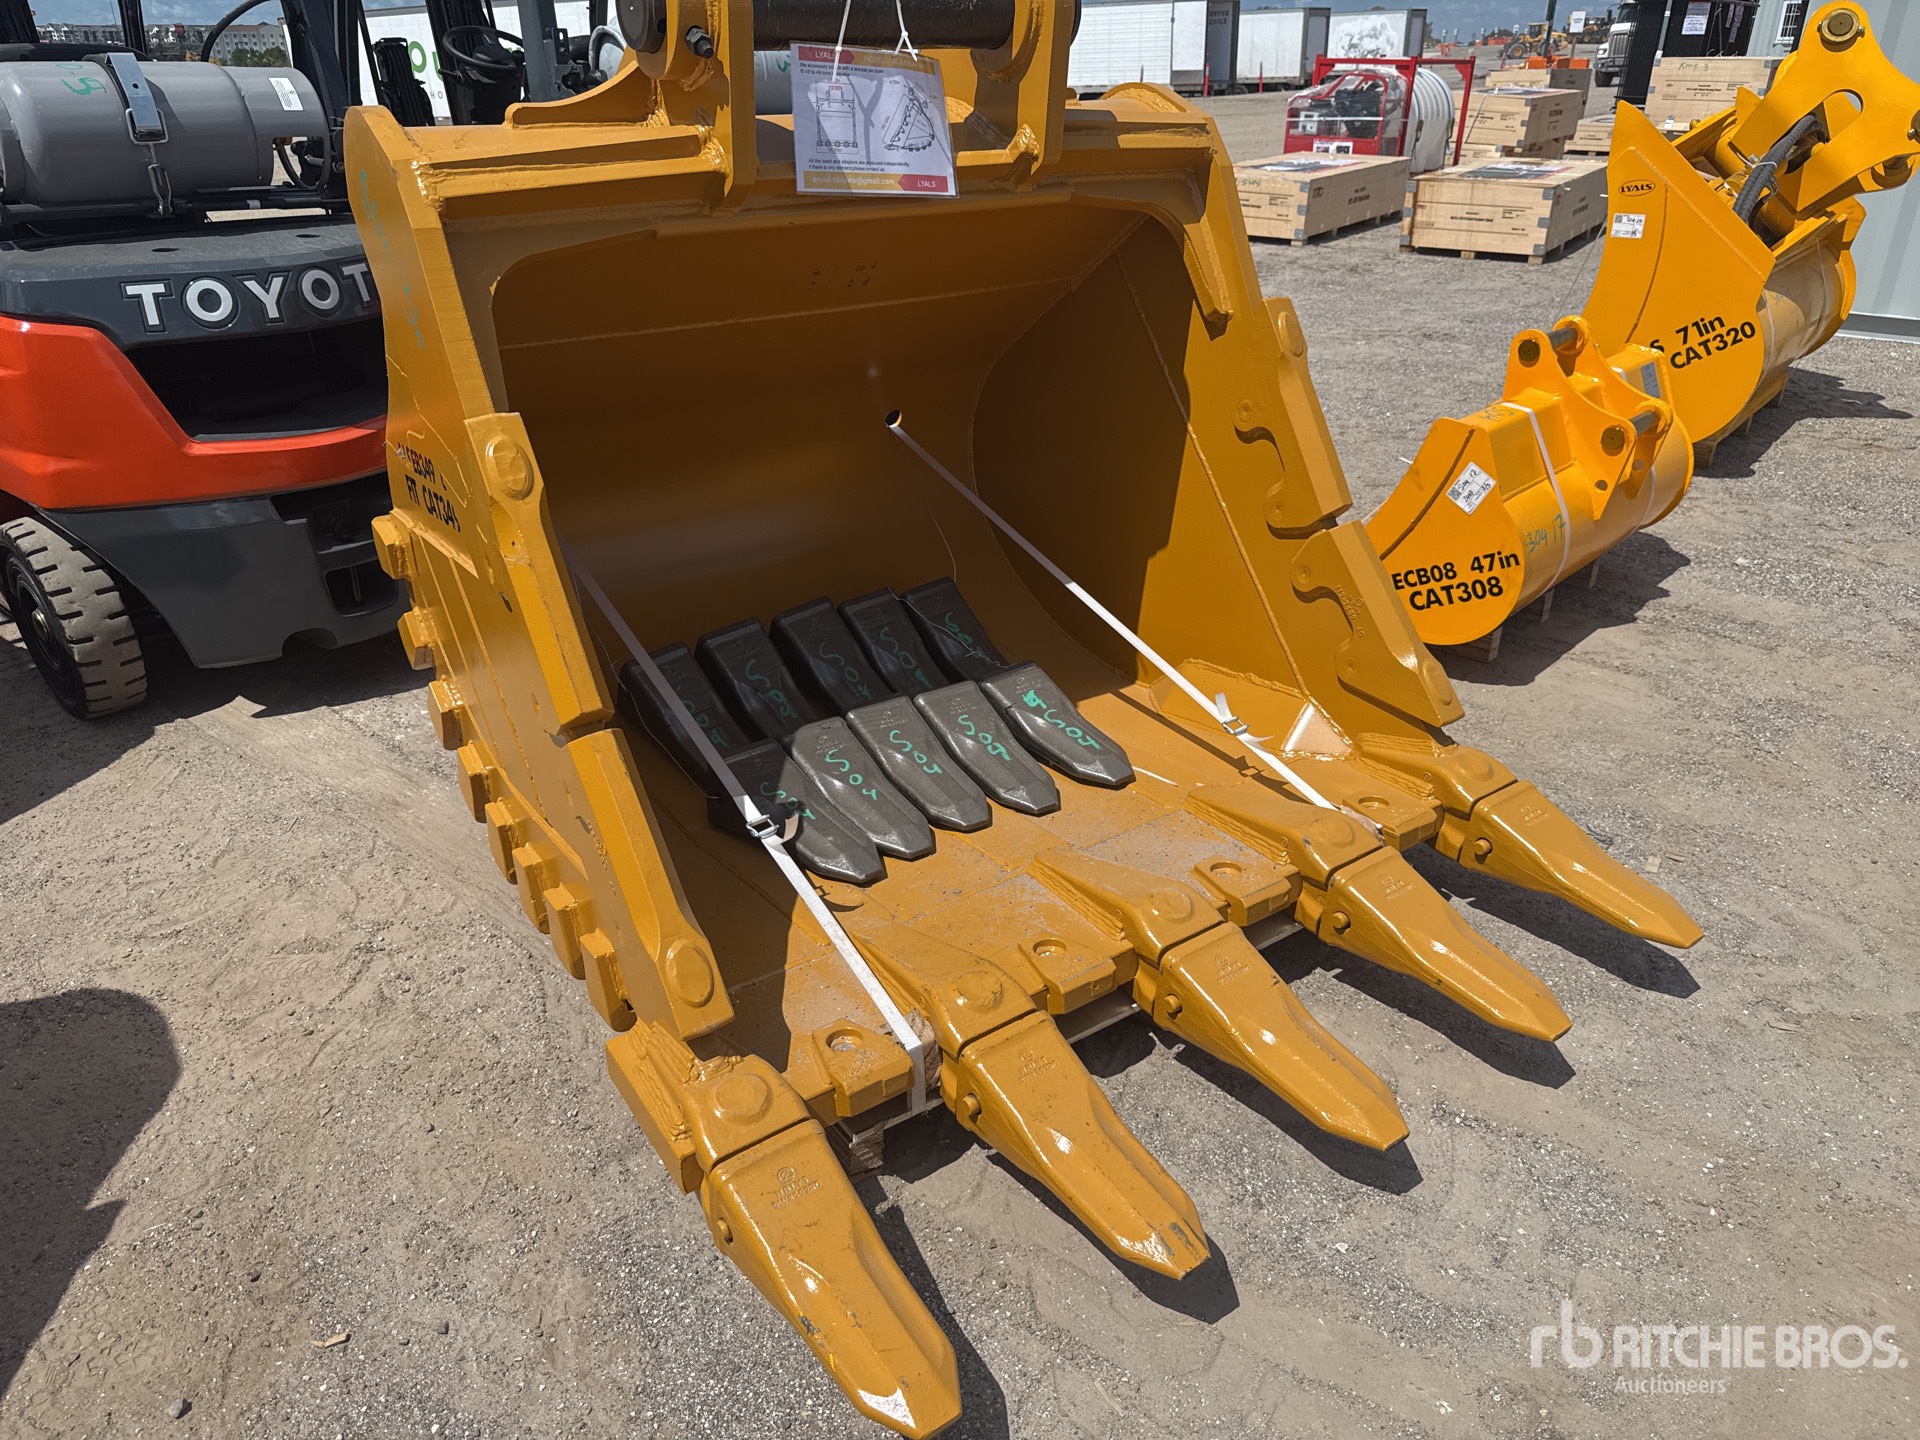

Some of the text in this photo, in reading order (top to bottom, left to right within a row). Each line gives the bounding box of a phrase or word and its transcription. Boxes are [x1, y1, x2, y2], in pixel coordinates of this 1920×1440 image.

[917, 180, 936, 188] LYALS
[1620, 183, 1653, 193] LYALS
[124, 262, 371, 326] TOYOT
[1670, 321, 1756, 370] CAT320
[1391, 550, 1520, 591] ECB08 47in
[1409, 575, 1504, 612] CAT308
